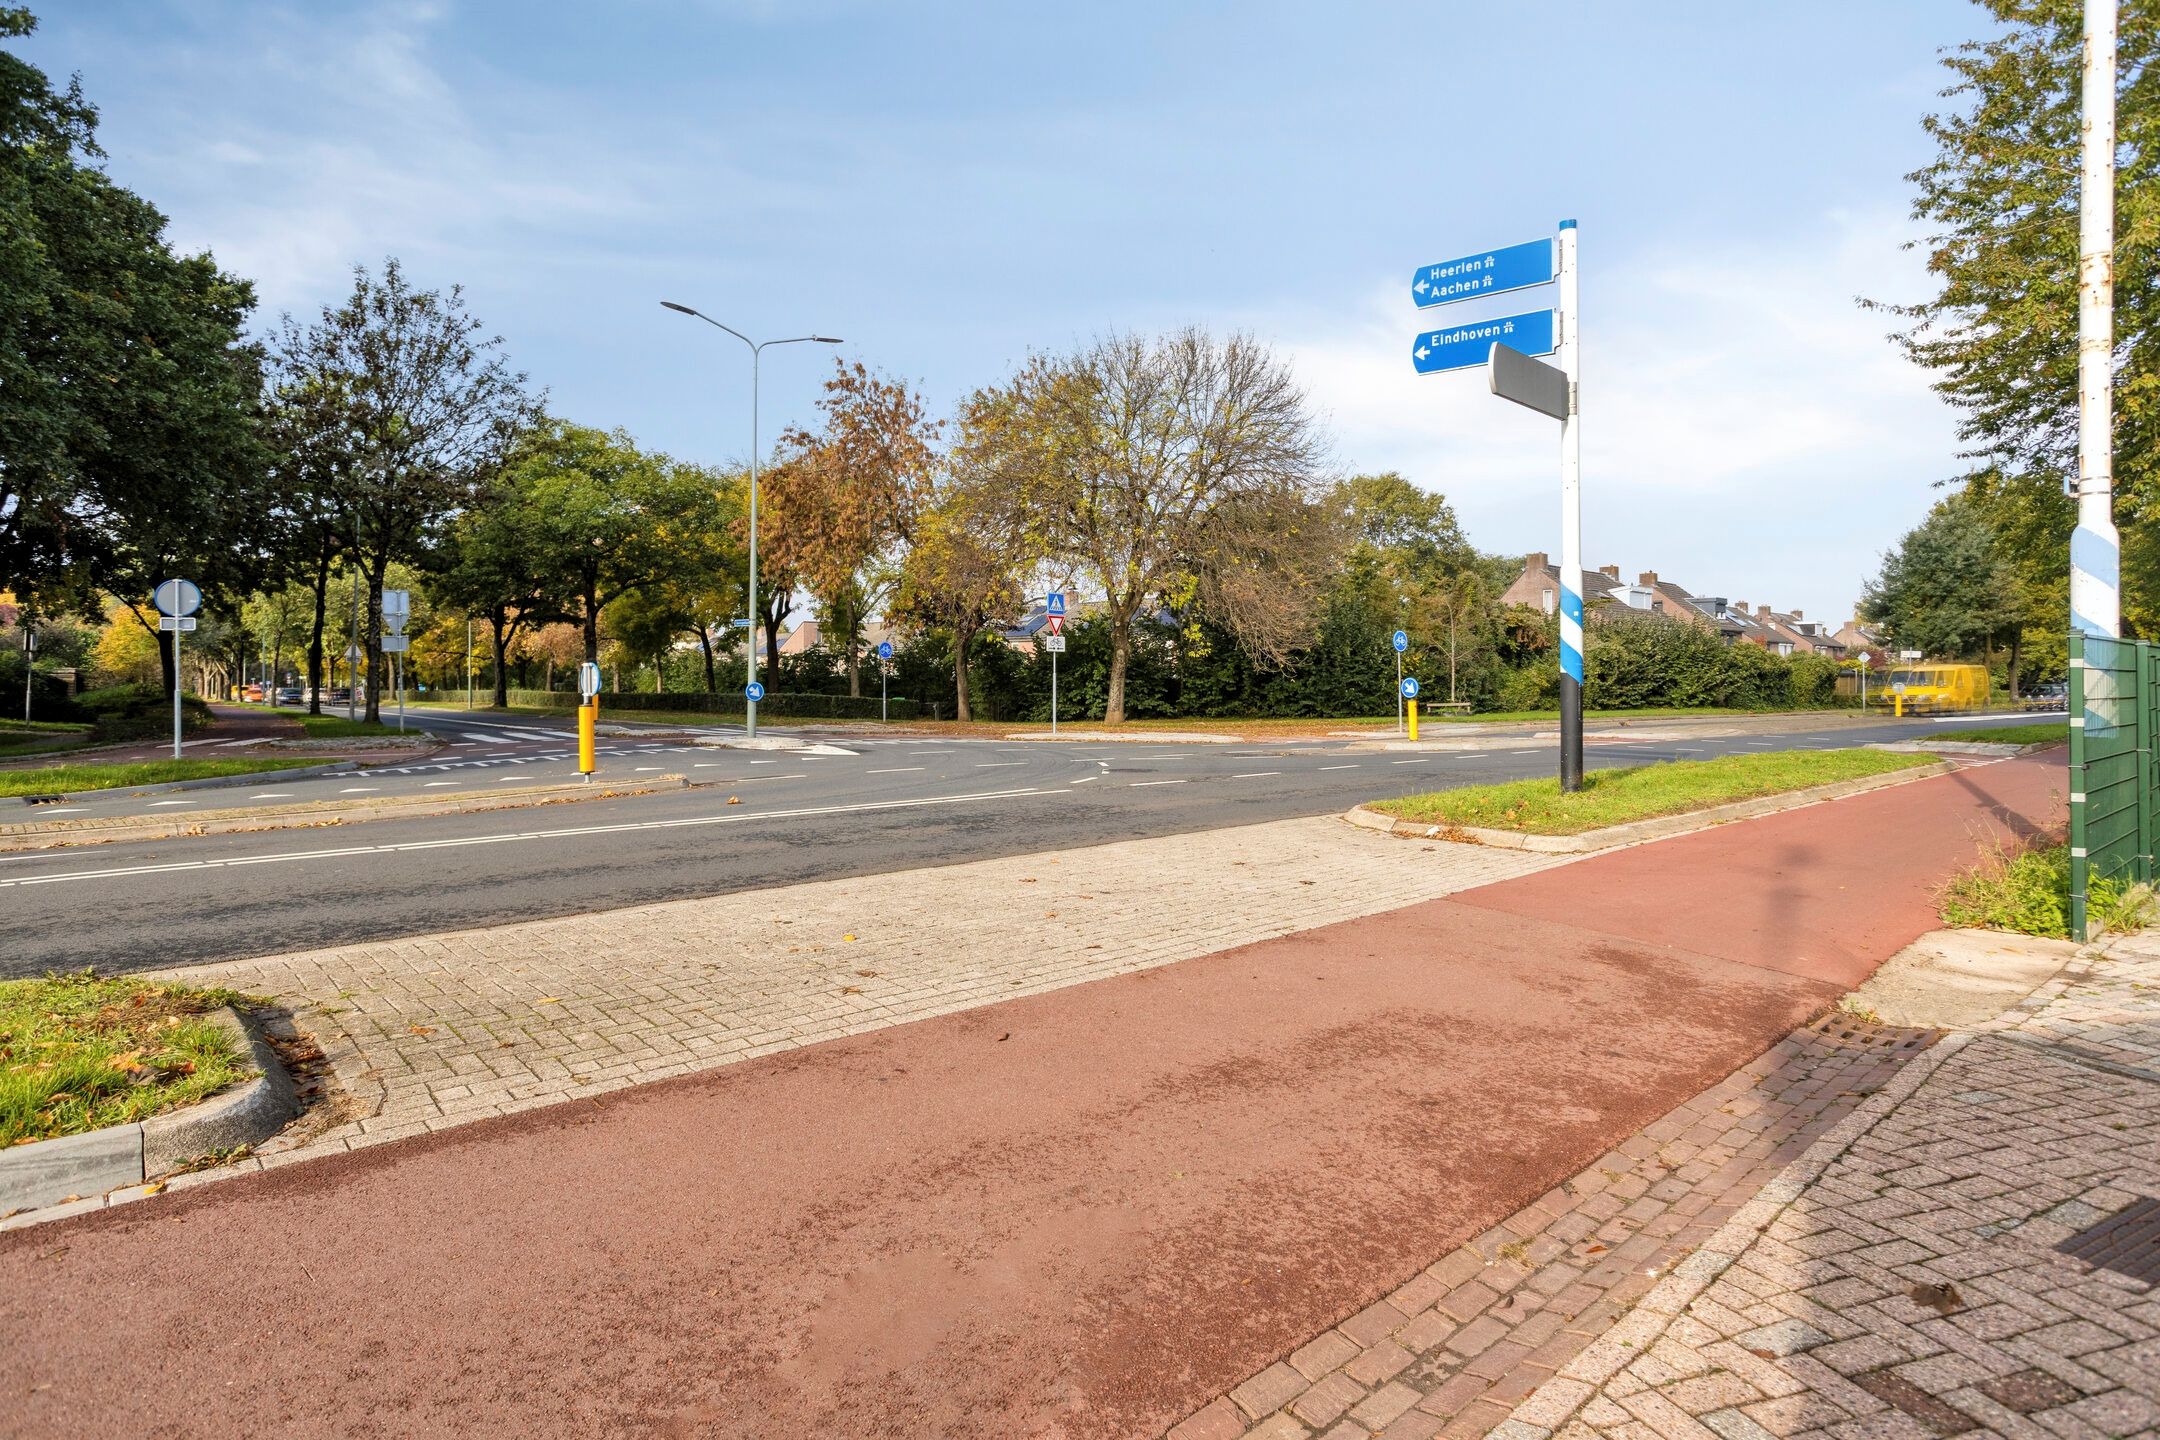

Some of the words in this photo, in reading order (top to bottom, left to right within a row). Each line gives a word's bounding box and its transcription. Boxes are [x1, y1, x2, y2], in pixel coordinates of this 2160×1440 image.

[1431, 260, 1481, 280] Heerlen
[1431, 280, 1479, 298] Aachen
[1431, 325, 1500, 347] Eindhoven
